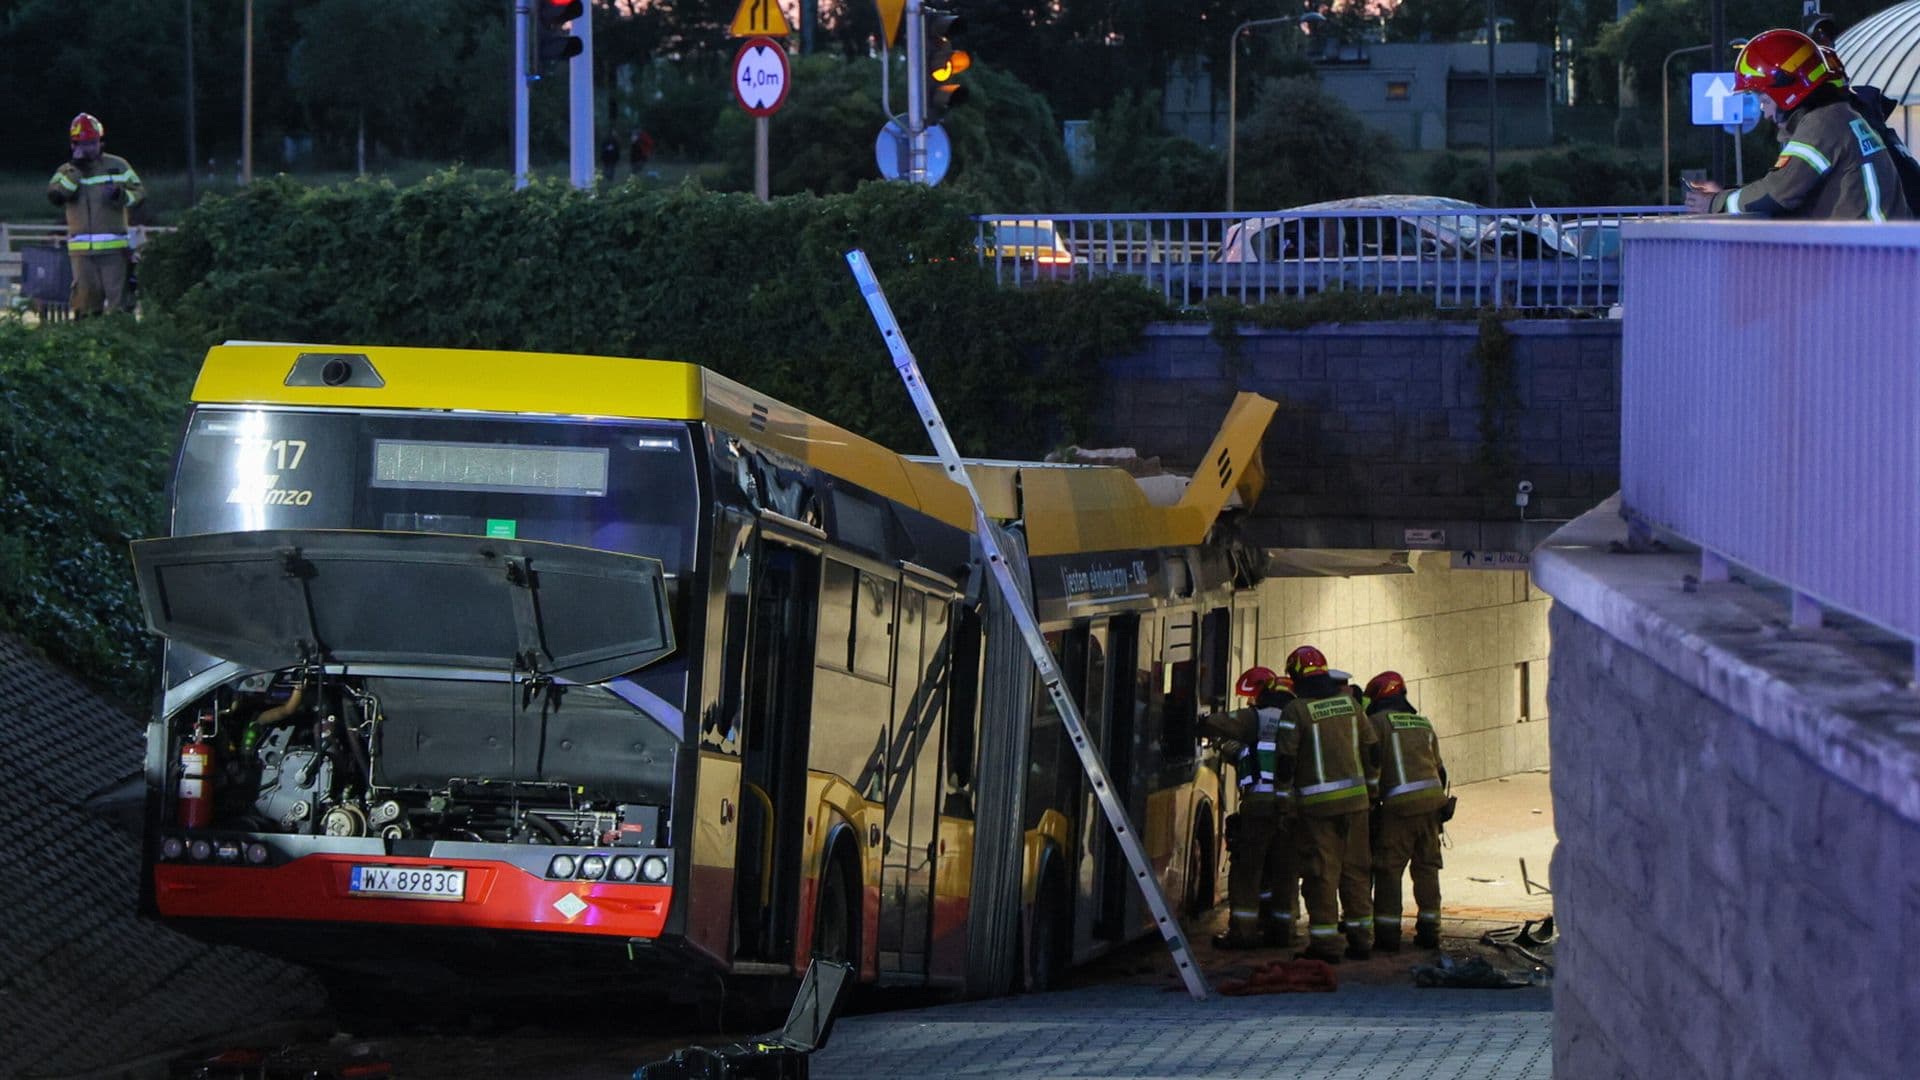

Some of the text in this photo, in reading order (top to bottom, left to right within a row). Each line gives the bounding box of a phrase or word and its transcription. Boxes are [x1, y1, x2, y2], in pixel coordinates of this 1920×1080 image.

[742, 66, 779, 88] 4,0m
[364, 869, 390, 890] WX
[397, 871, 458, 893] 8983C
